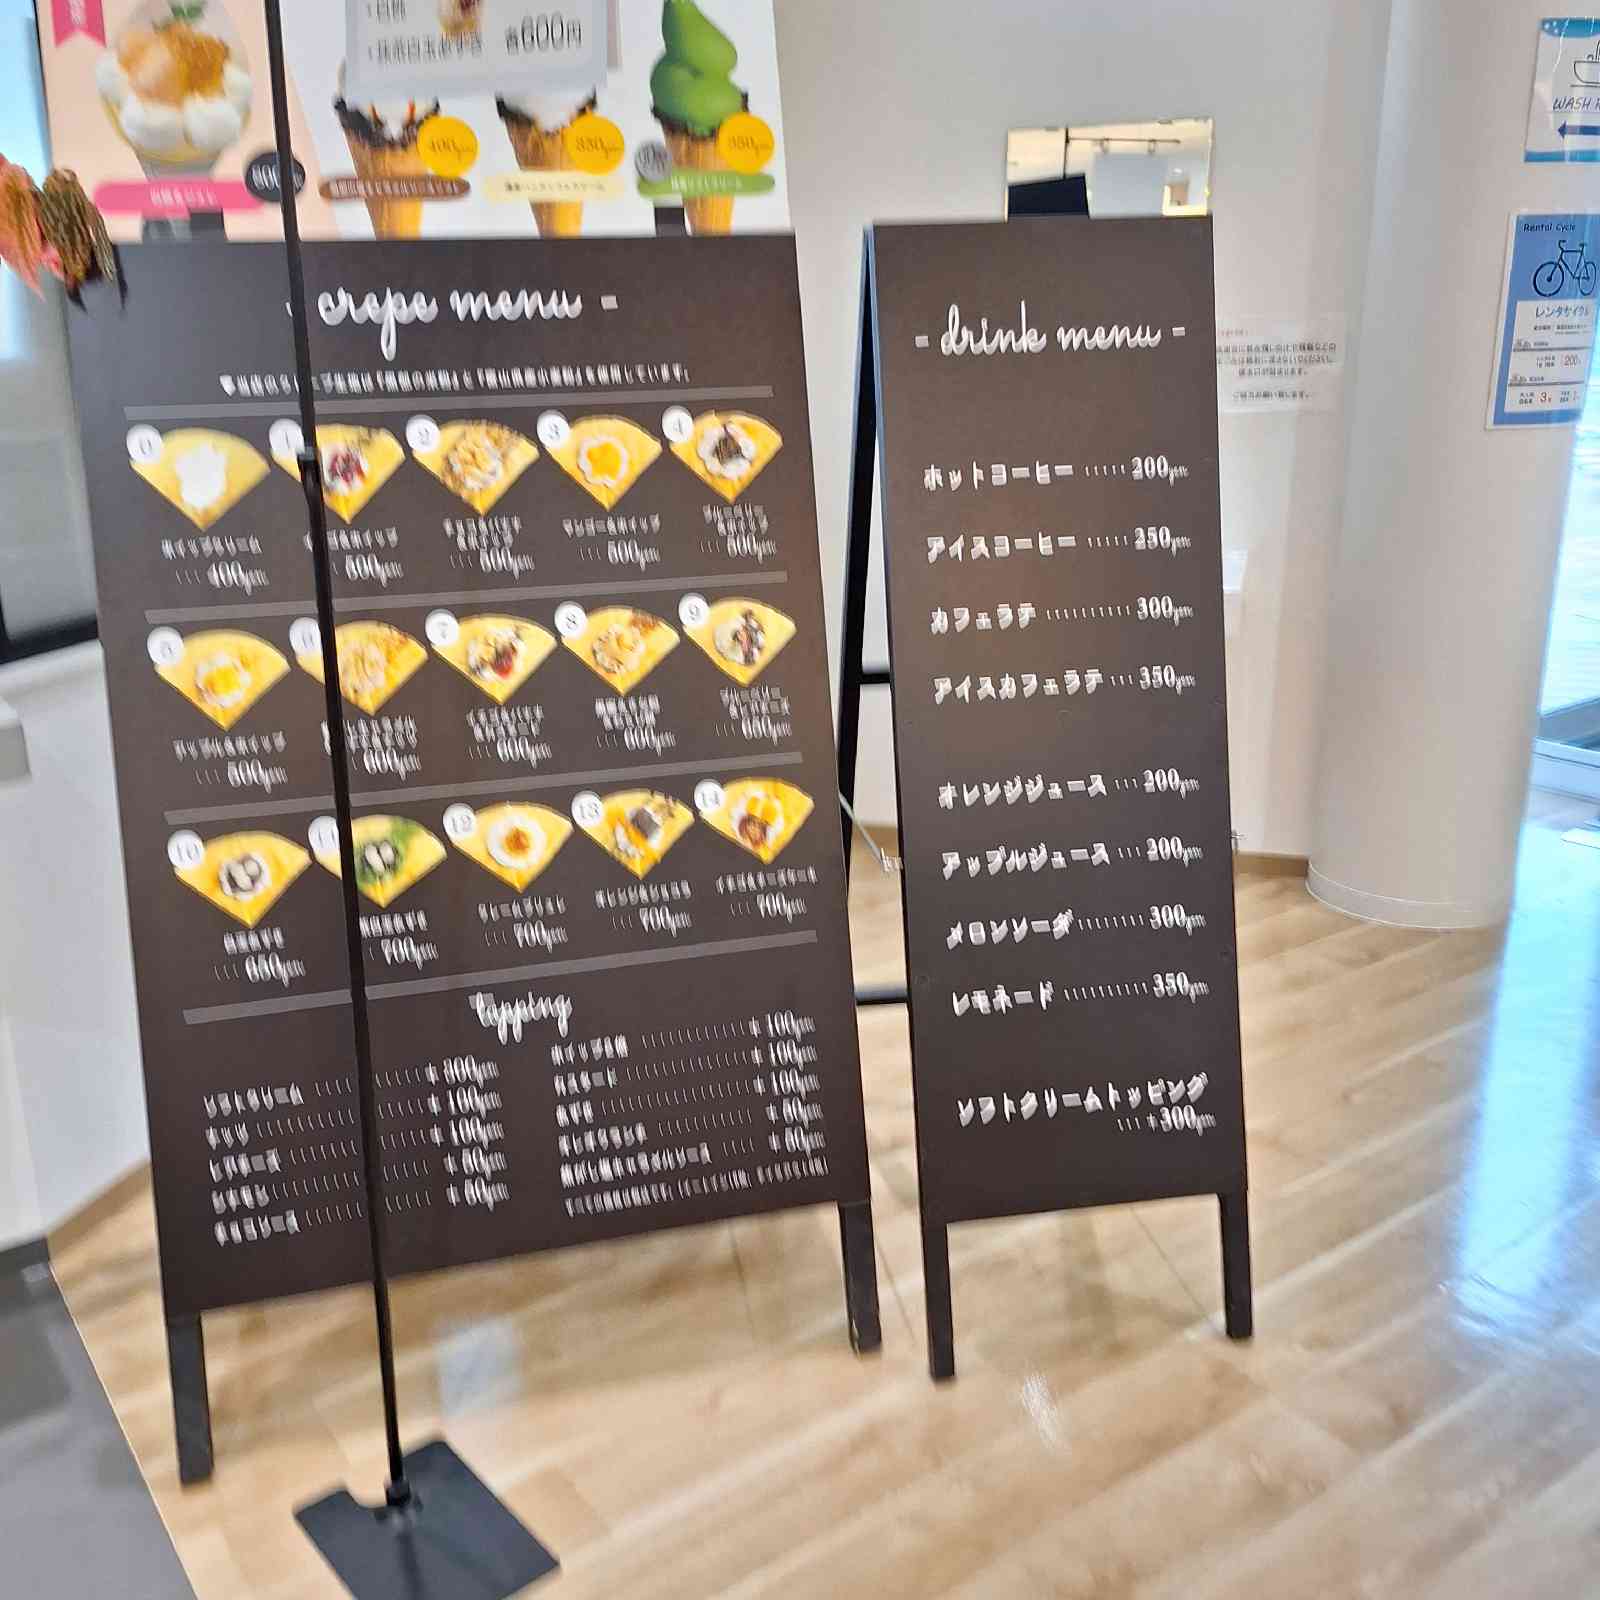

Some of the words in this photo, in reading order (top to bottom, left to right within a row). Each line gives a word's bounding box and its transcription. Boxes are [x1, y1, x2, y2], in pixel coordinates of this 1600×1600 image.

[1553, 97, 1591, 111] WASH
[1523, 222, 1553, 233] Rental
[1556, 223, 1577, 233] Cycle
[317, 286, 438, 361] crepe
[450, 288, 582, 321] menu
[941, 300, 1047, 355] drink
[1056, 324, 1162, 351] menu
[923, 460, 1073, 492] ホットコーヒー
[1131, 455, 1190, 487] 200yen
[927, 531, 1077, 563] アイスコーヒー
[1134, 525, 1192, 558] 250yen
[930, 602, 1037, 635] カフェラテ
[1136, 595, 1193, 627] 300yen
[933, 668, 1103, 705] アイスカフェラテ
[1139, 664, 1196, 696] 350yen
[938, 773, 1107, 810] オレンジジュース
[1143, 768, 1200, 799] 200yen
[941, 842, 1110, 880] アップルジュース
[1146, 836, 1203, 868] 200yen
[946, 908, 1074, 950] メロンソーダ
[1150, 904, 1207, 936] 300yen
[952, 980, 1054, 1017] レモネード
[1152, 972, 1210, 1004] 350yen
[957, 1071, 1209, 1129] ソフトクリームトッピング
